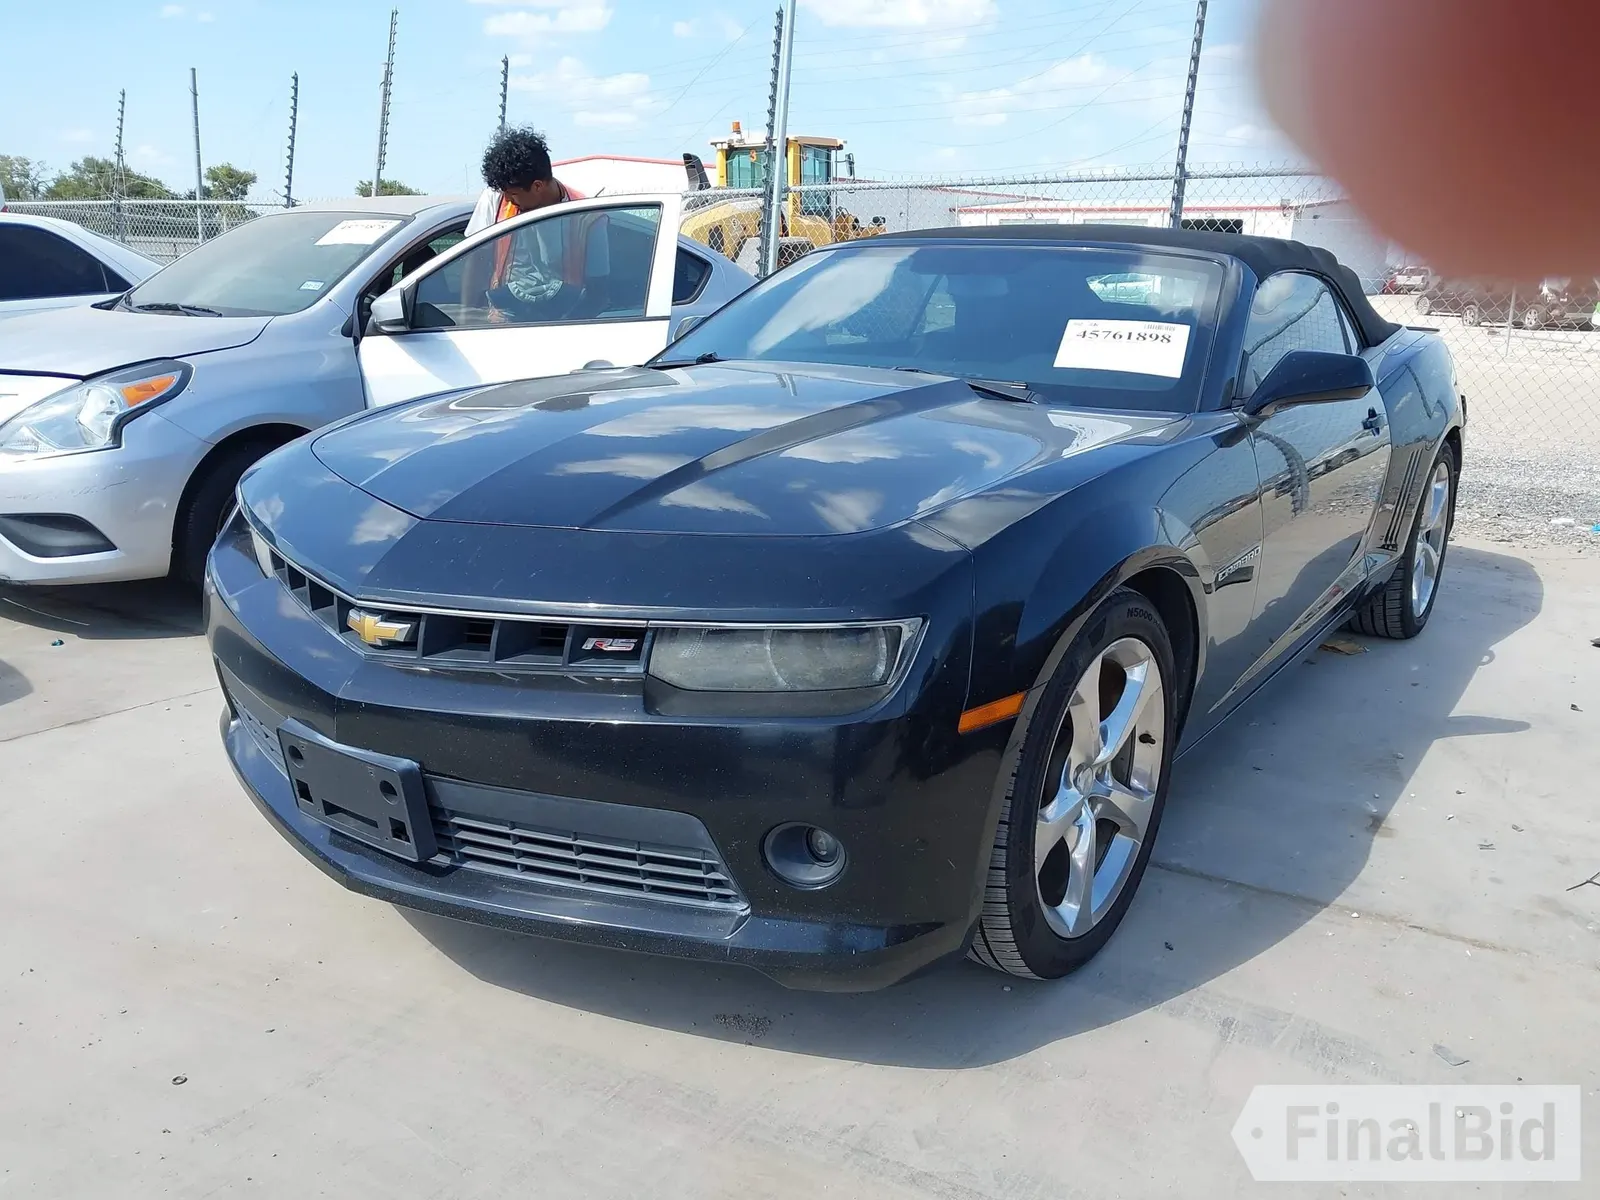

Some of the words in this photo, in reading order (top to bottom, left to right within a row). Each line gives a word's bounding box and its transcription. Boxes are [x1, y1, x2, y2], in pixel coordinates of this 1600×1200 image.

[1076, 330, 1172, 344] 45761898
[1126, 607, 1153, 621] N5000
[581, 637, 638, 651] RS
